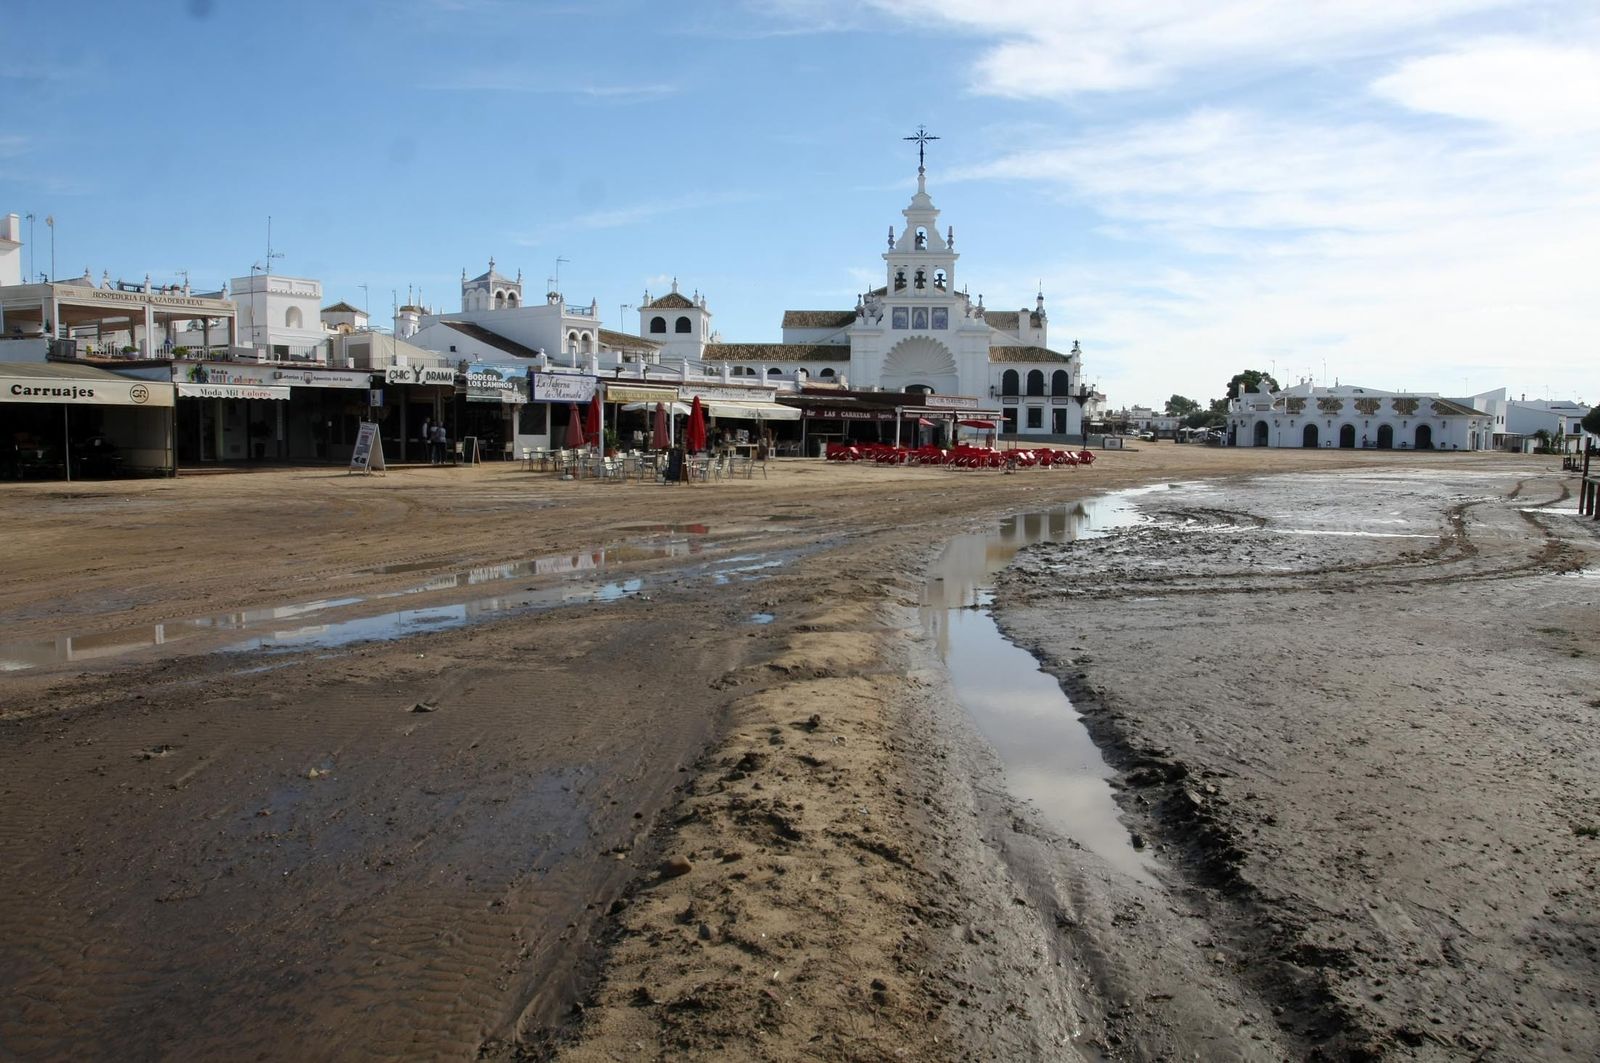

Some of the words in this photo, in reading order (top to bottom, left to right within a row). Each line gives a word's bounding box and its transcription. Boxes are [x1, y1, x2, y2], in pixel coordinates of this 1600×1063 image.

[389, 370, 410, 380] CHIC
[426, 371, 452, 382] DRAMA
[467, 373, 497, 381] BODEGA
[482, 381, 513, 389] CAMINOS
[10, 384, 95, 399] Carruajes
[200, 388, 222, 396] Moda
[241, 389, 271, 397] Colores
